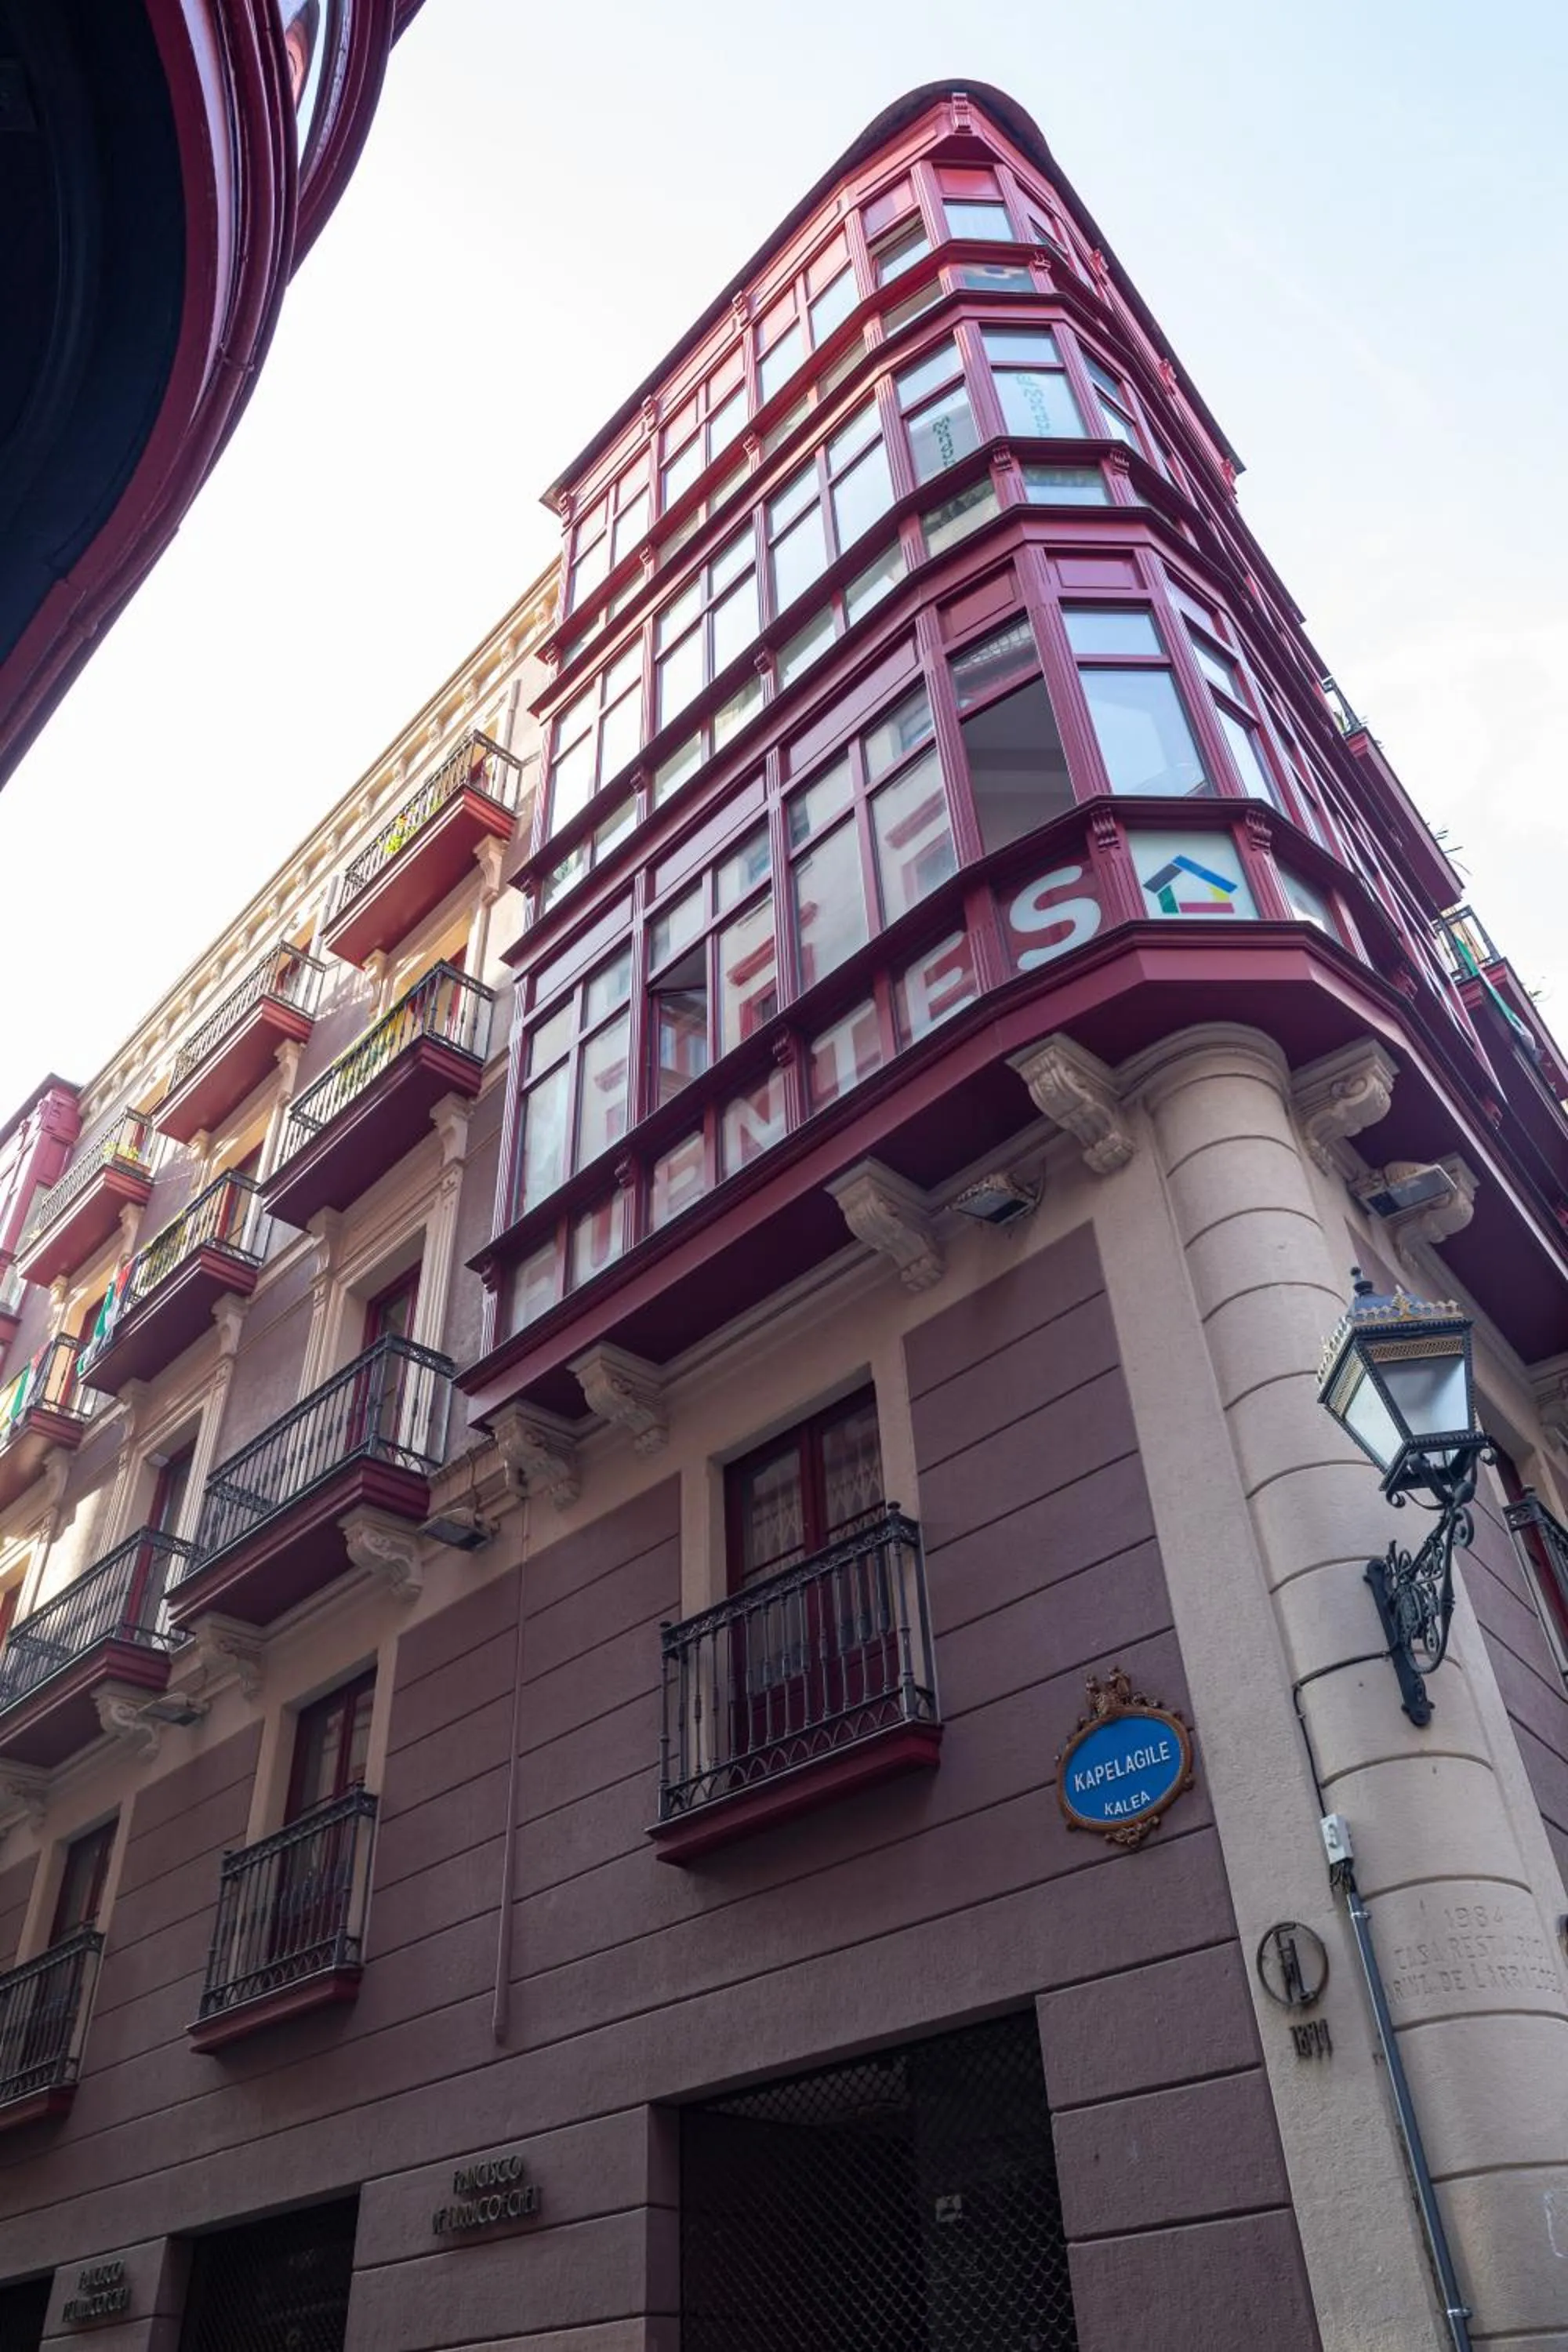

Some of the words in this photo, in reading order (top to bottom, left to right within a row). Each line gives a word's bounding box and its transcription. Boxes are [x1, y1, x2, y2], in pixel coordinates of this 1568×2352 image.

[511, 865, 1102, 1336] FUENTES
[1074, 1741, 1171, 1792] KAPELAGILE
[1104, 1791, 1151, 1816] KALEA
